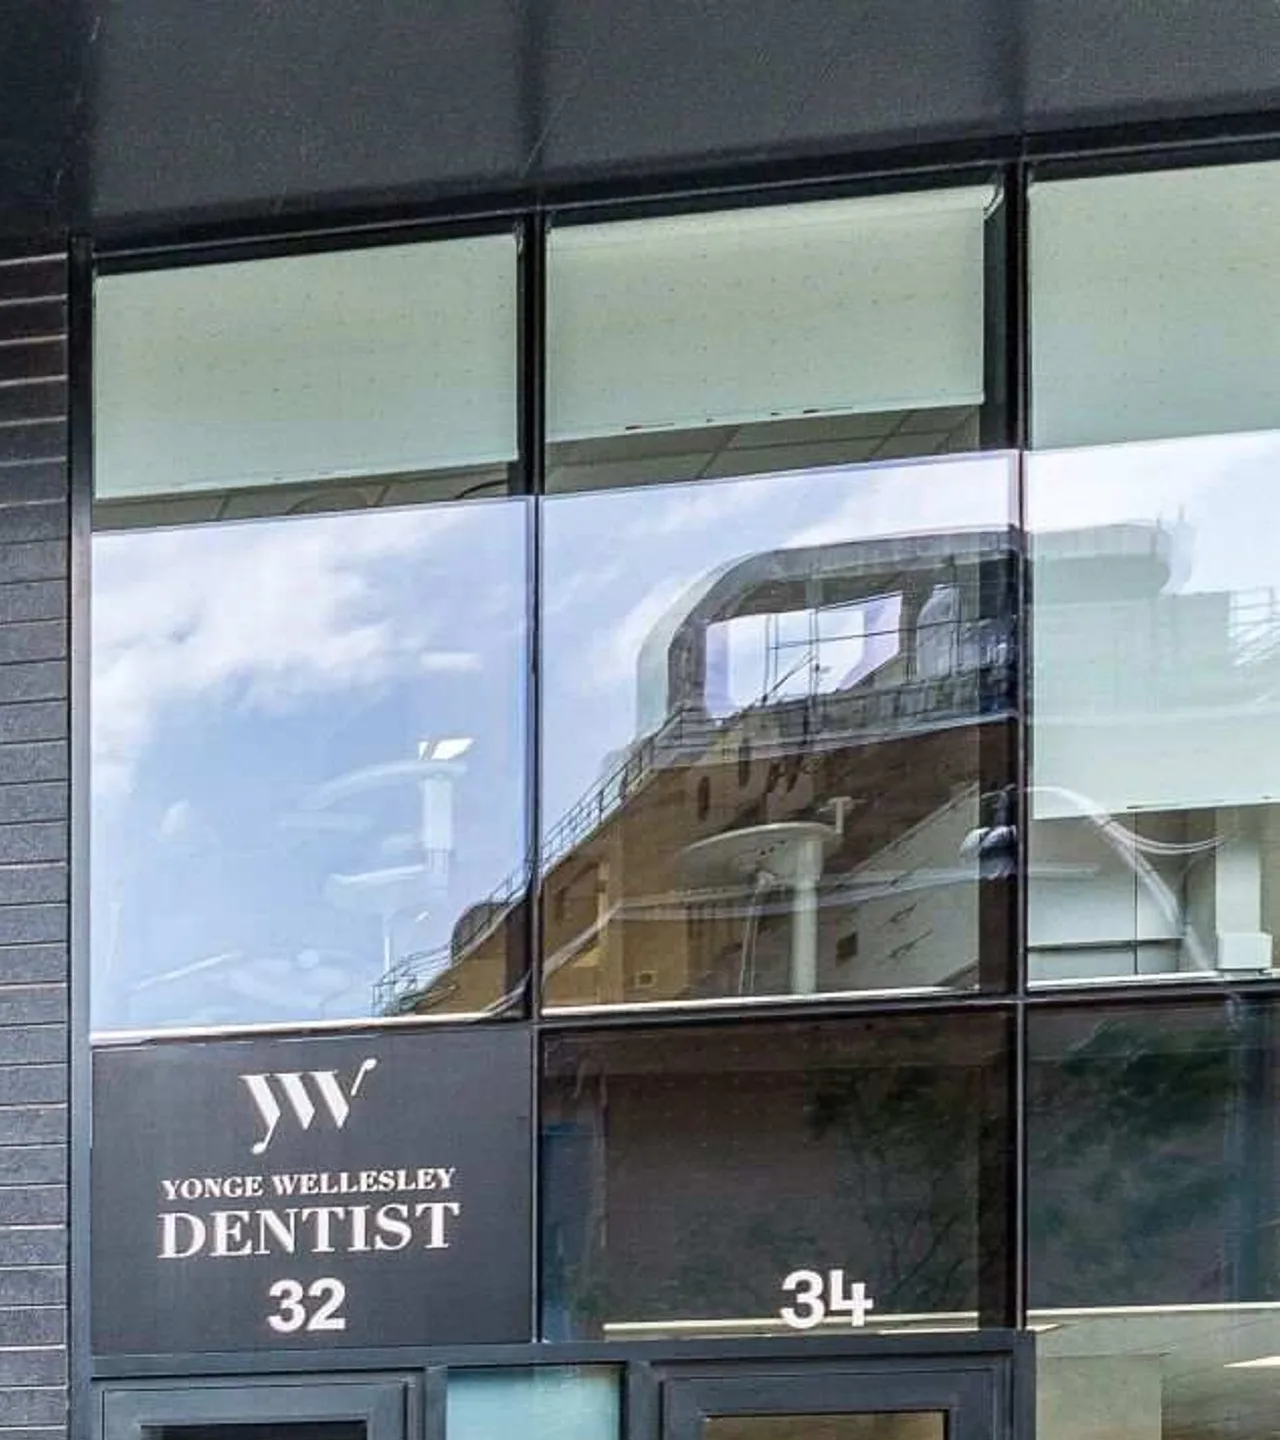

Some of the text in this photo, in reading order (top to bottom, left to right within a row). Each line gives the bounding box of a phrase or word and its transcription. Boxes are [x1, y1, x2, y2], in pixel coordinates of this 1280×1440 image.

[161, 1167, 455, 1200] YONGE WELLESLEY
[157, 1203, 461, 1259] DENTIST
[268, 1278, 346, 1332] 32
[780, 1269, 874, 1329] 34
